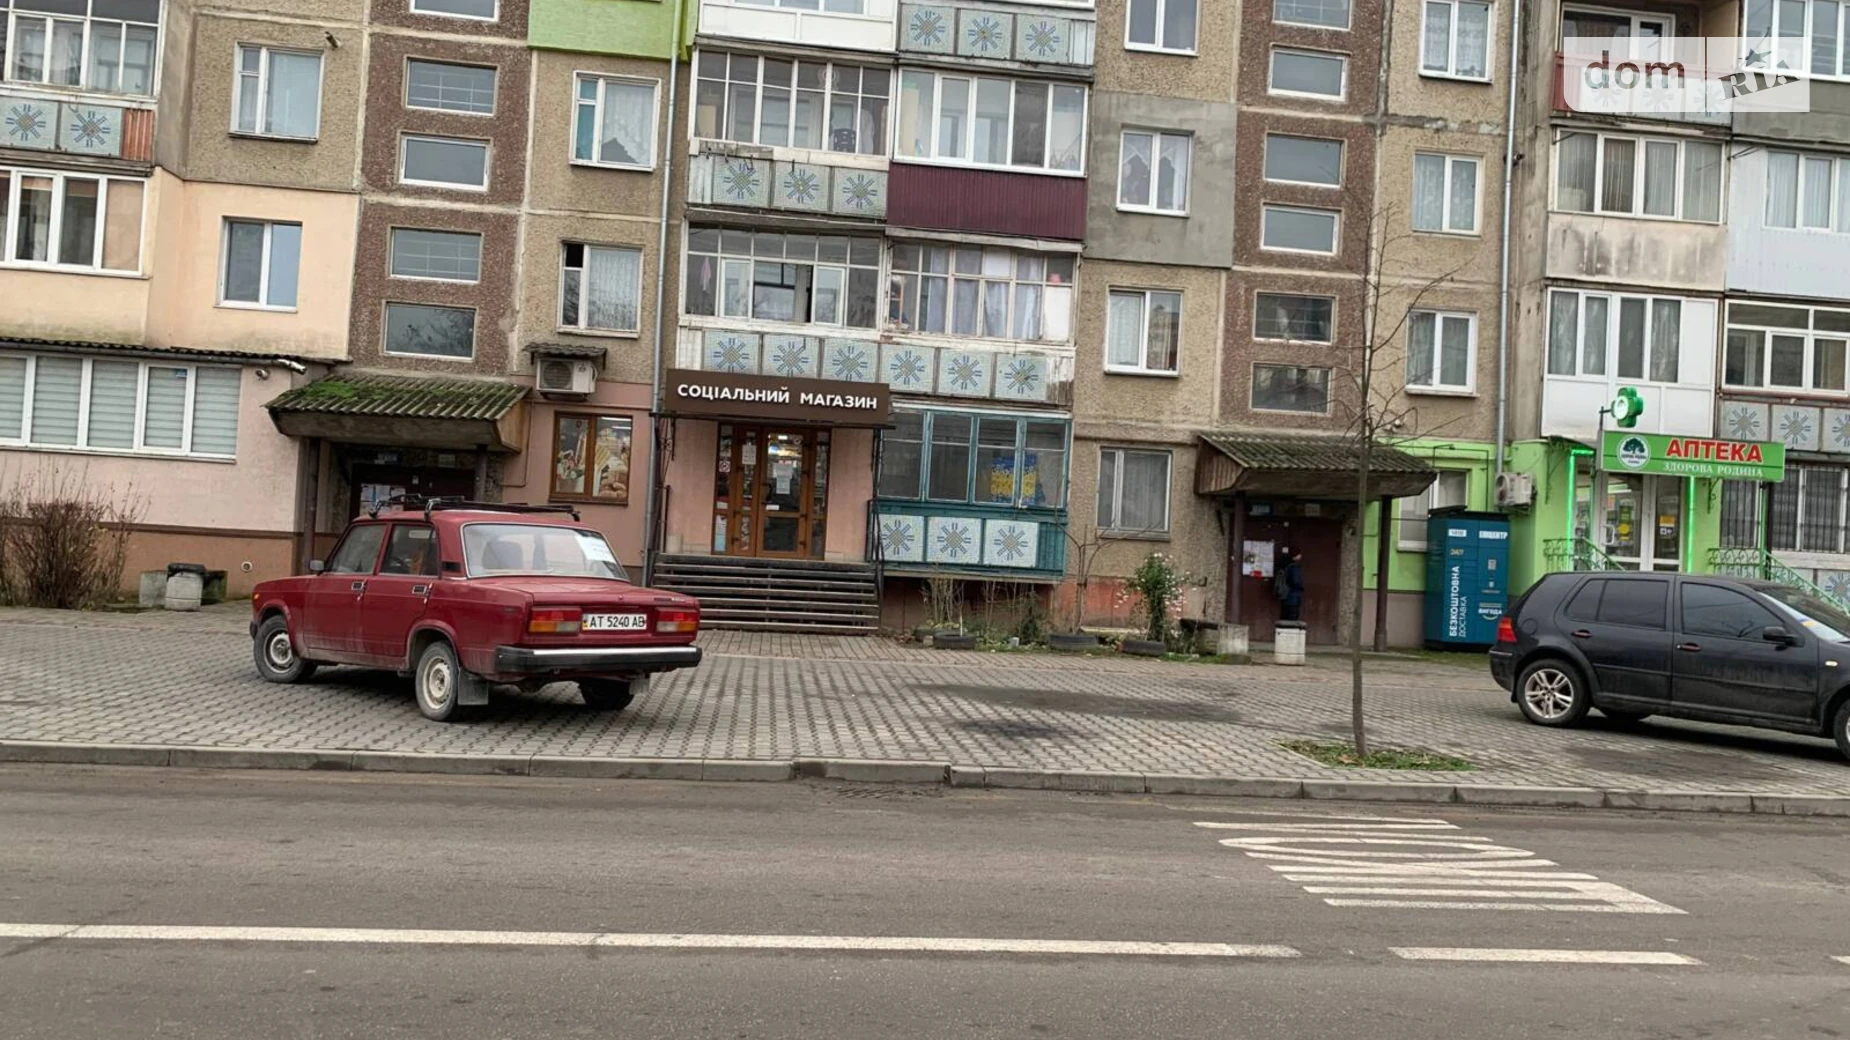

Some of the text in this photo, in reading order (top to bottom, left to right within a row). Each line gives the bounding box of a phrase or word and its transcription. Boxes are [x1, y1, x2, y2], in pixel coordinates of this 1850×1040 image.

[677, 384, 878, 409] СОЦІАЛЬНИЙ МАГАЗИН
[1665, 438, 1763, 463] АПТЕКА
[1664, 462, 1763, 477] ЗДОРОВА РОДИНА
[1449, 566, 1460, 637] БЕЗКОШТОВНА
[590, 616, 604, 627] AT
[607, 616, 630, 627] 5240
[1458, 596, 1467, 637] ДОСТАВКА
